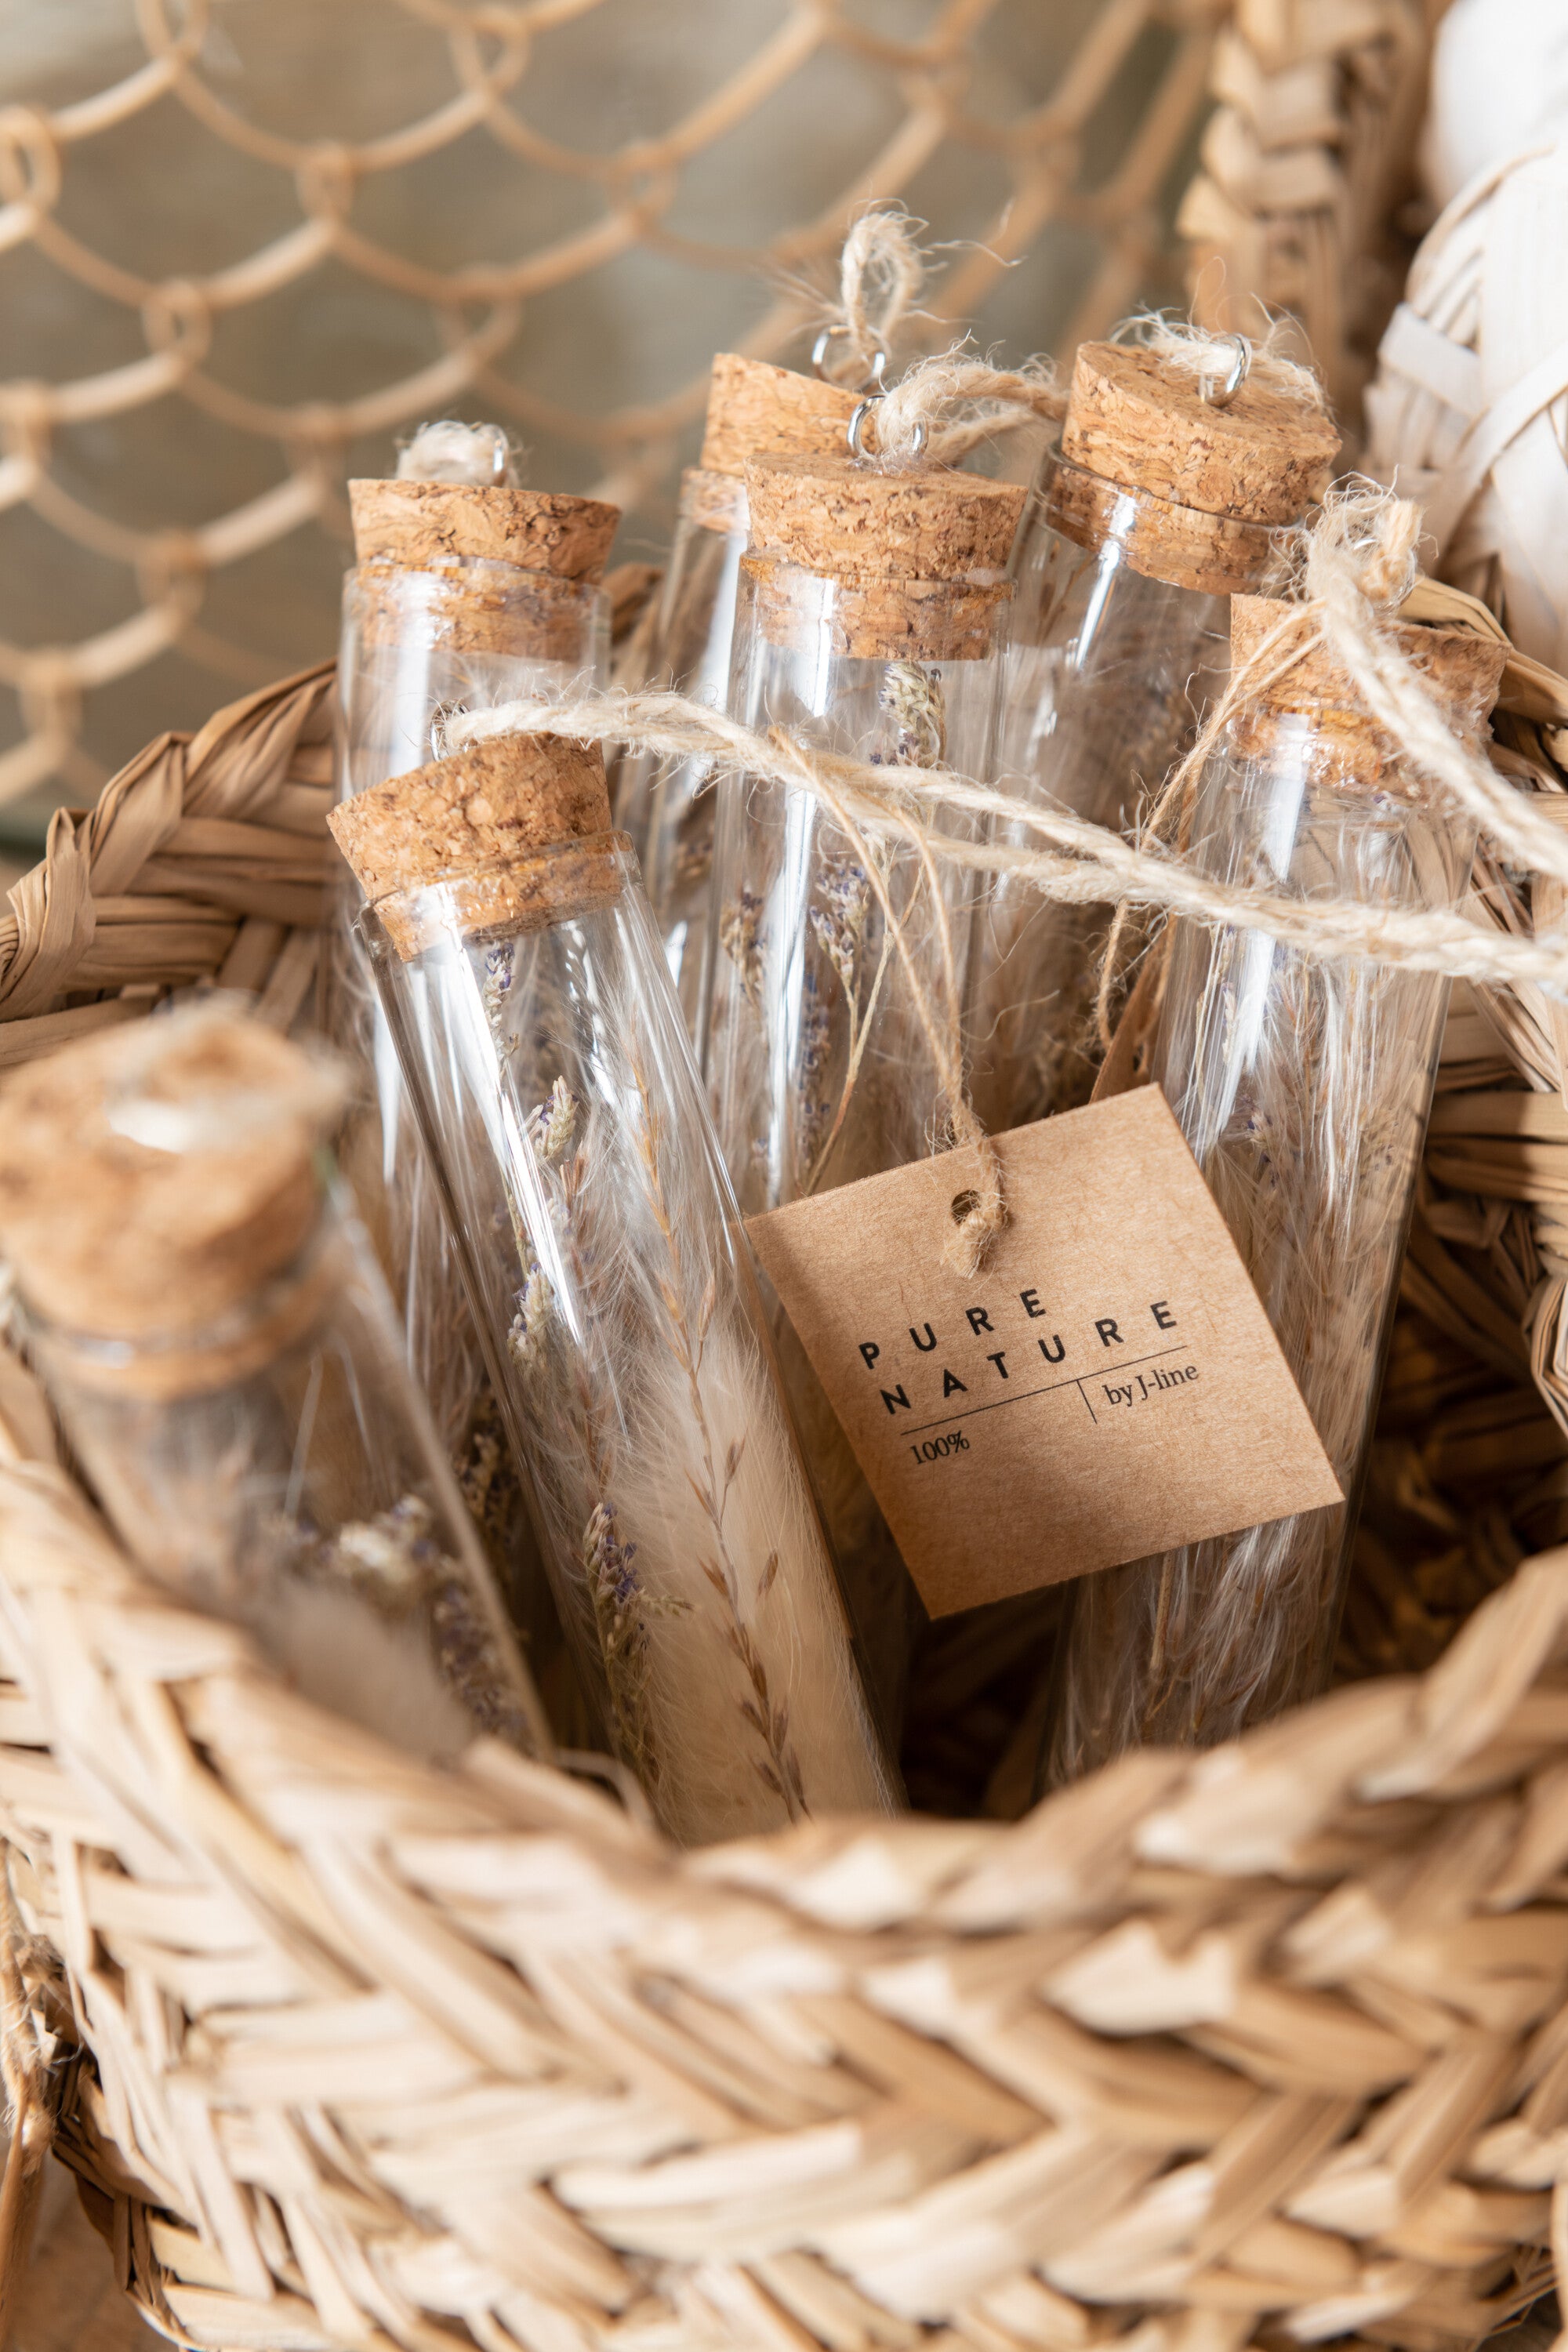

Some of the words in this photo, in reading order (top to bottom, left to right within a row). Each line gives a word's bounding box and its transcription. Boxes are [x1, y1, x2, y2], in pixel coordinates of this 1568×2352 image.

[858, 1289, 1046, 1370] PURE
[880, 1301, 1177, 1414] NATURE
[1102, 1384, 1133, 1407] by
[1136, 1364, 1199, 1400] J-line
[911, 1430, 970, 1465] 100%
